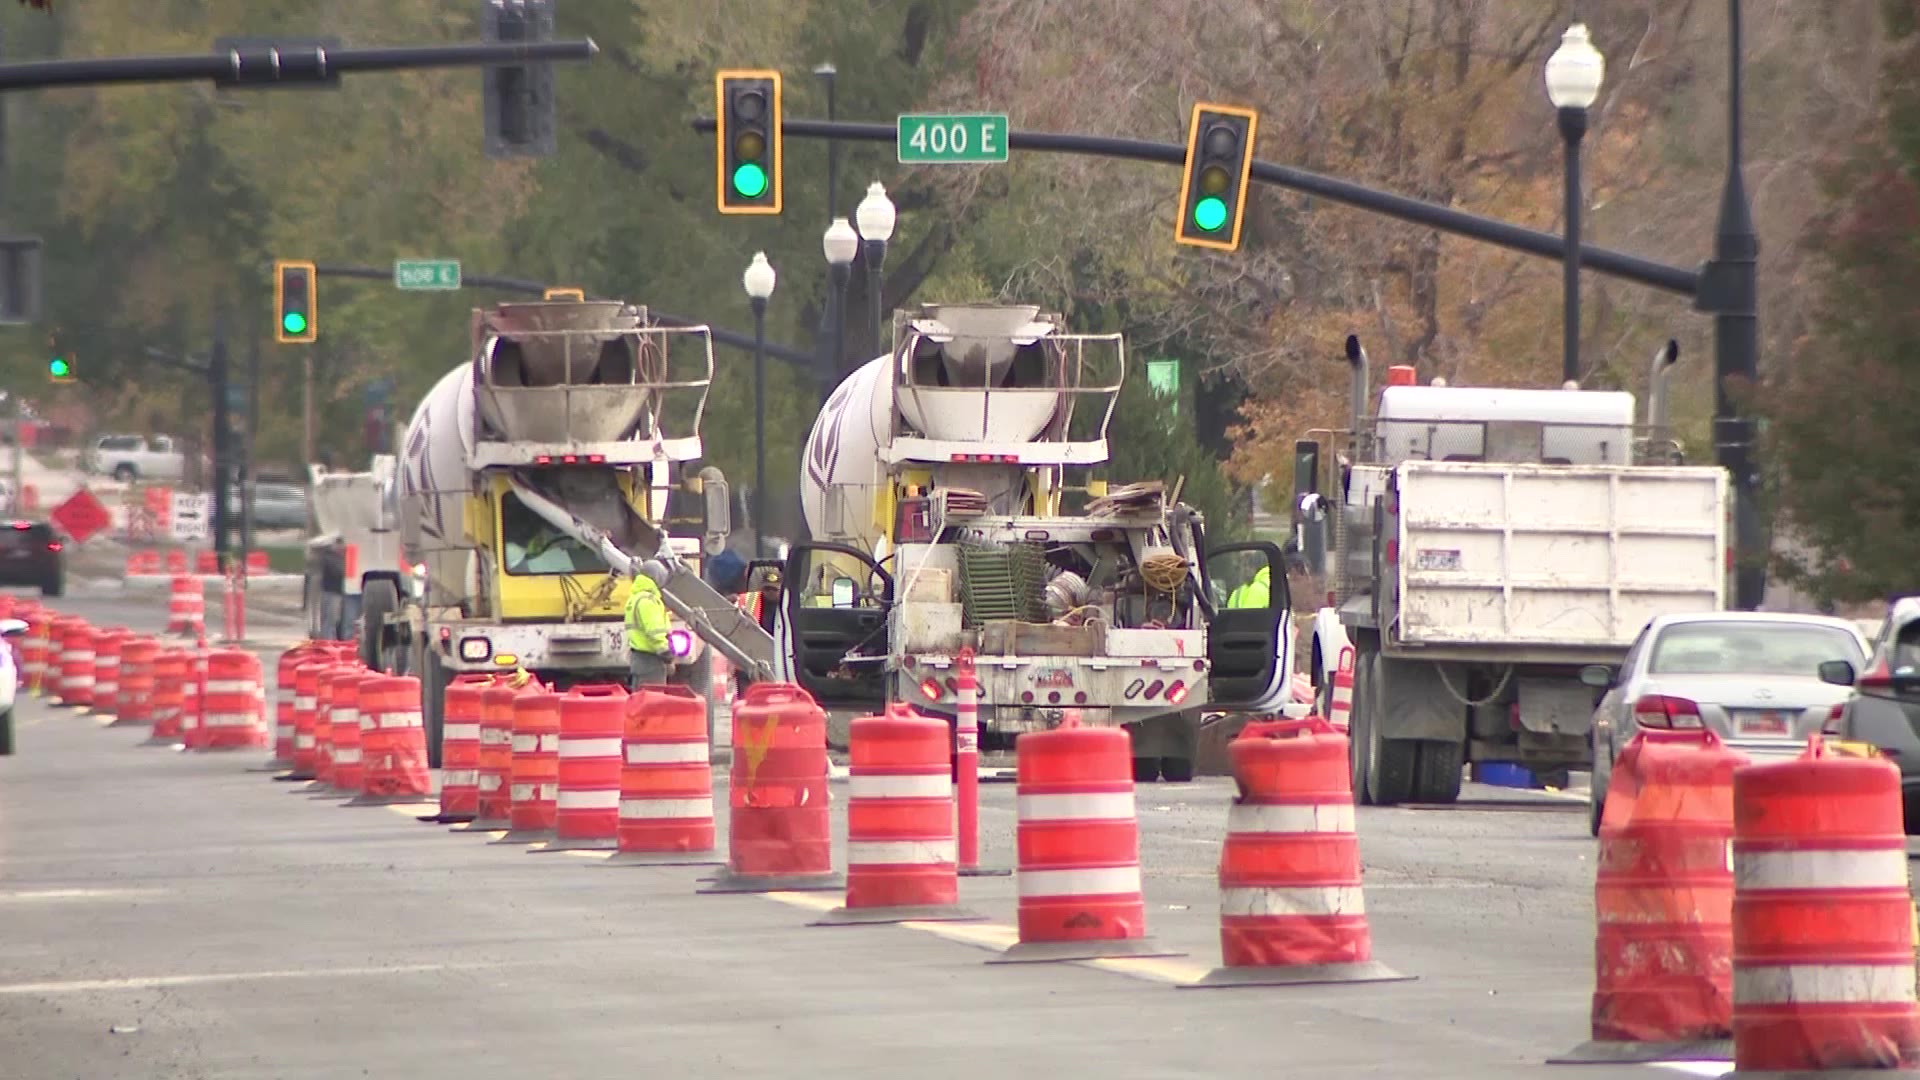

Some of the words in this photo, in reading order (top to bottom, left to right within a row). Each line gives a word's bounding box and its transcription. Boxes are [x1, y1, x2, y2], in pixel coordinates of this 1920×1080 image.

[909, 123, 968, 153] 400
[981, 123, 997, 153] E
[175, 522, 208, 532] RIGHT
[610, 632, 623, 650] 39
